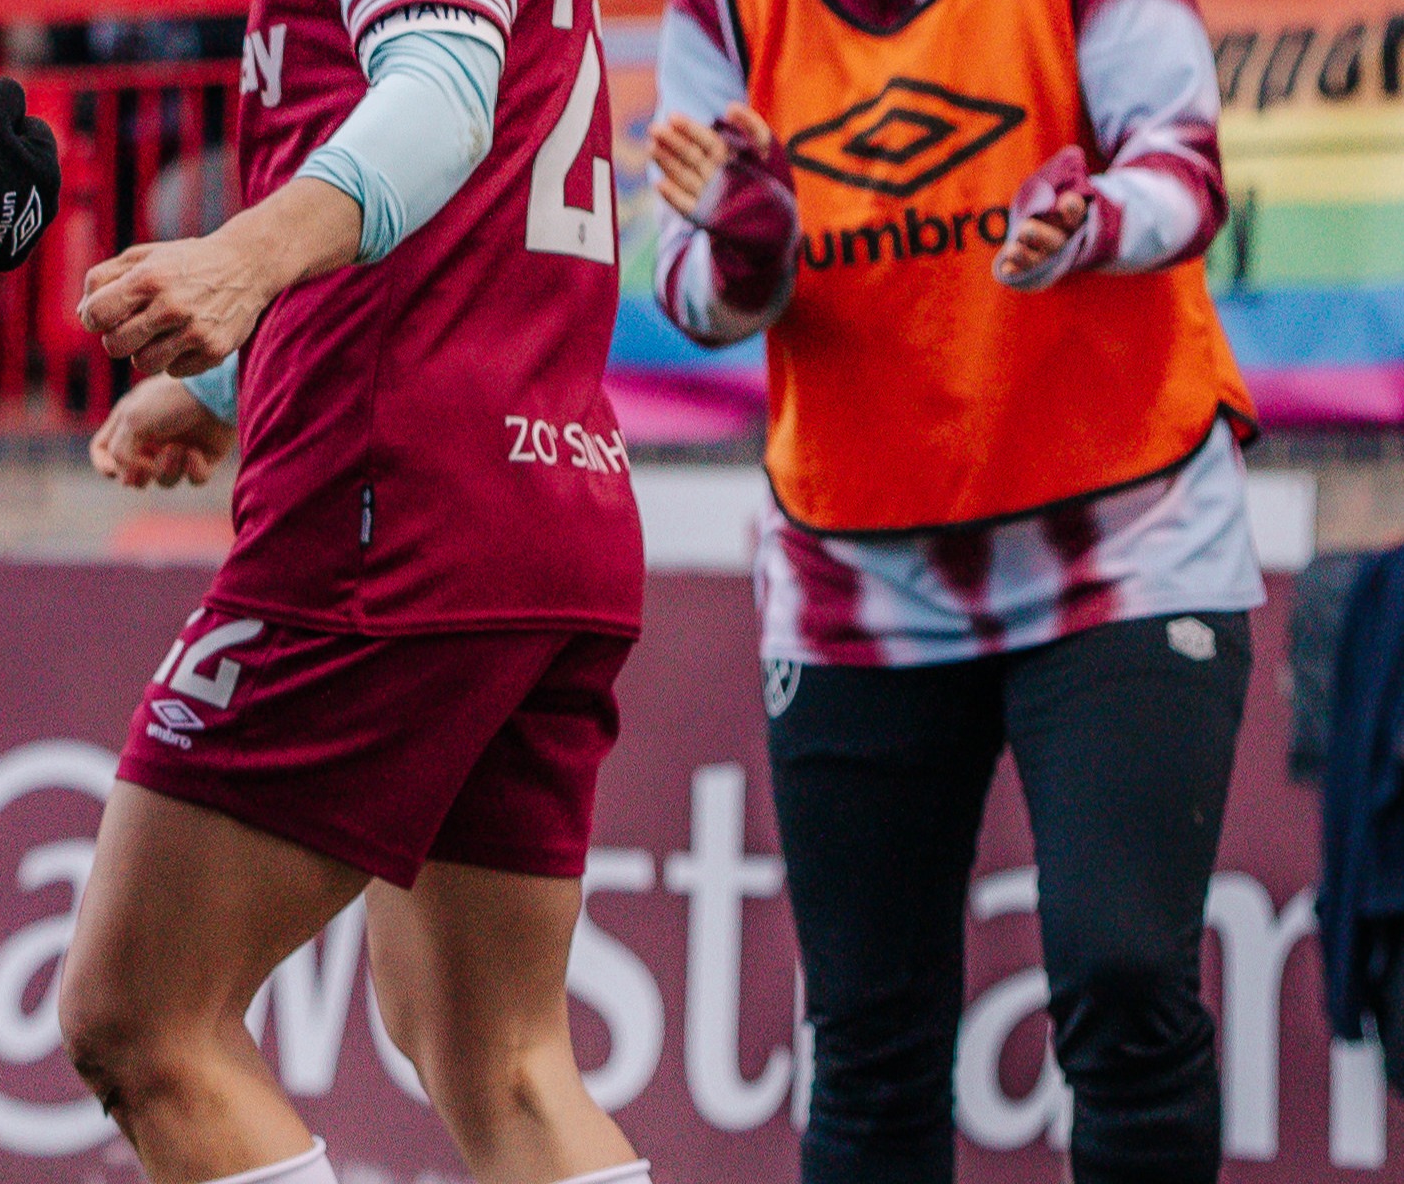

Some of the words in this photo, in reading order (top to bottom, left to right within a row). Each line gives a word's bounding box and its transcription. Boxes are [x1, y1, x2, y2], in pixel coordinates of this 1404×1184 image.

[801, 204, 1011, 272] umbro
[152, 606, 265, 711] 2
[146, 722, 192, 750] umbro
